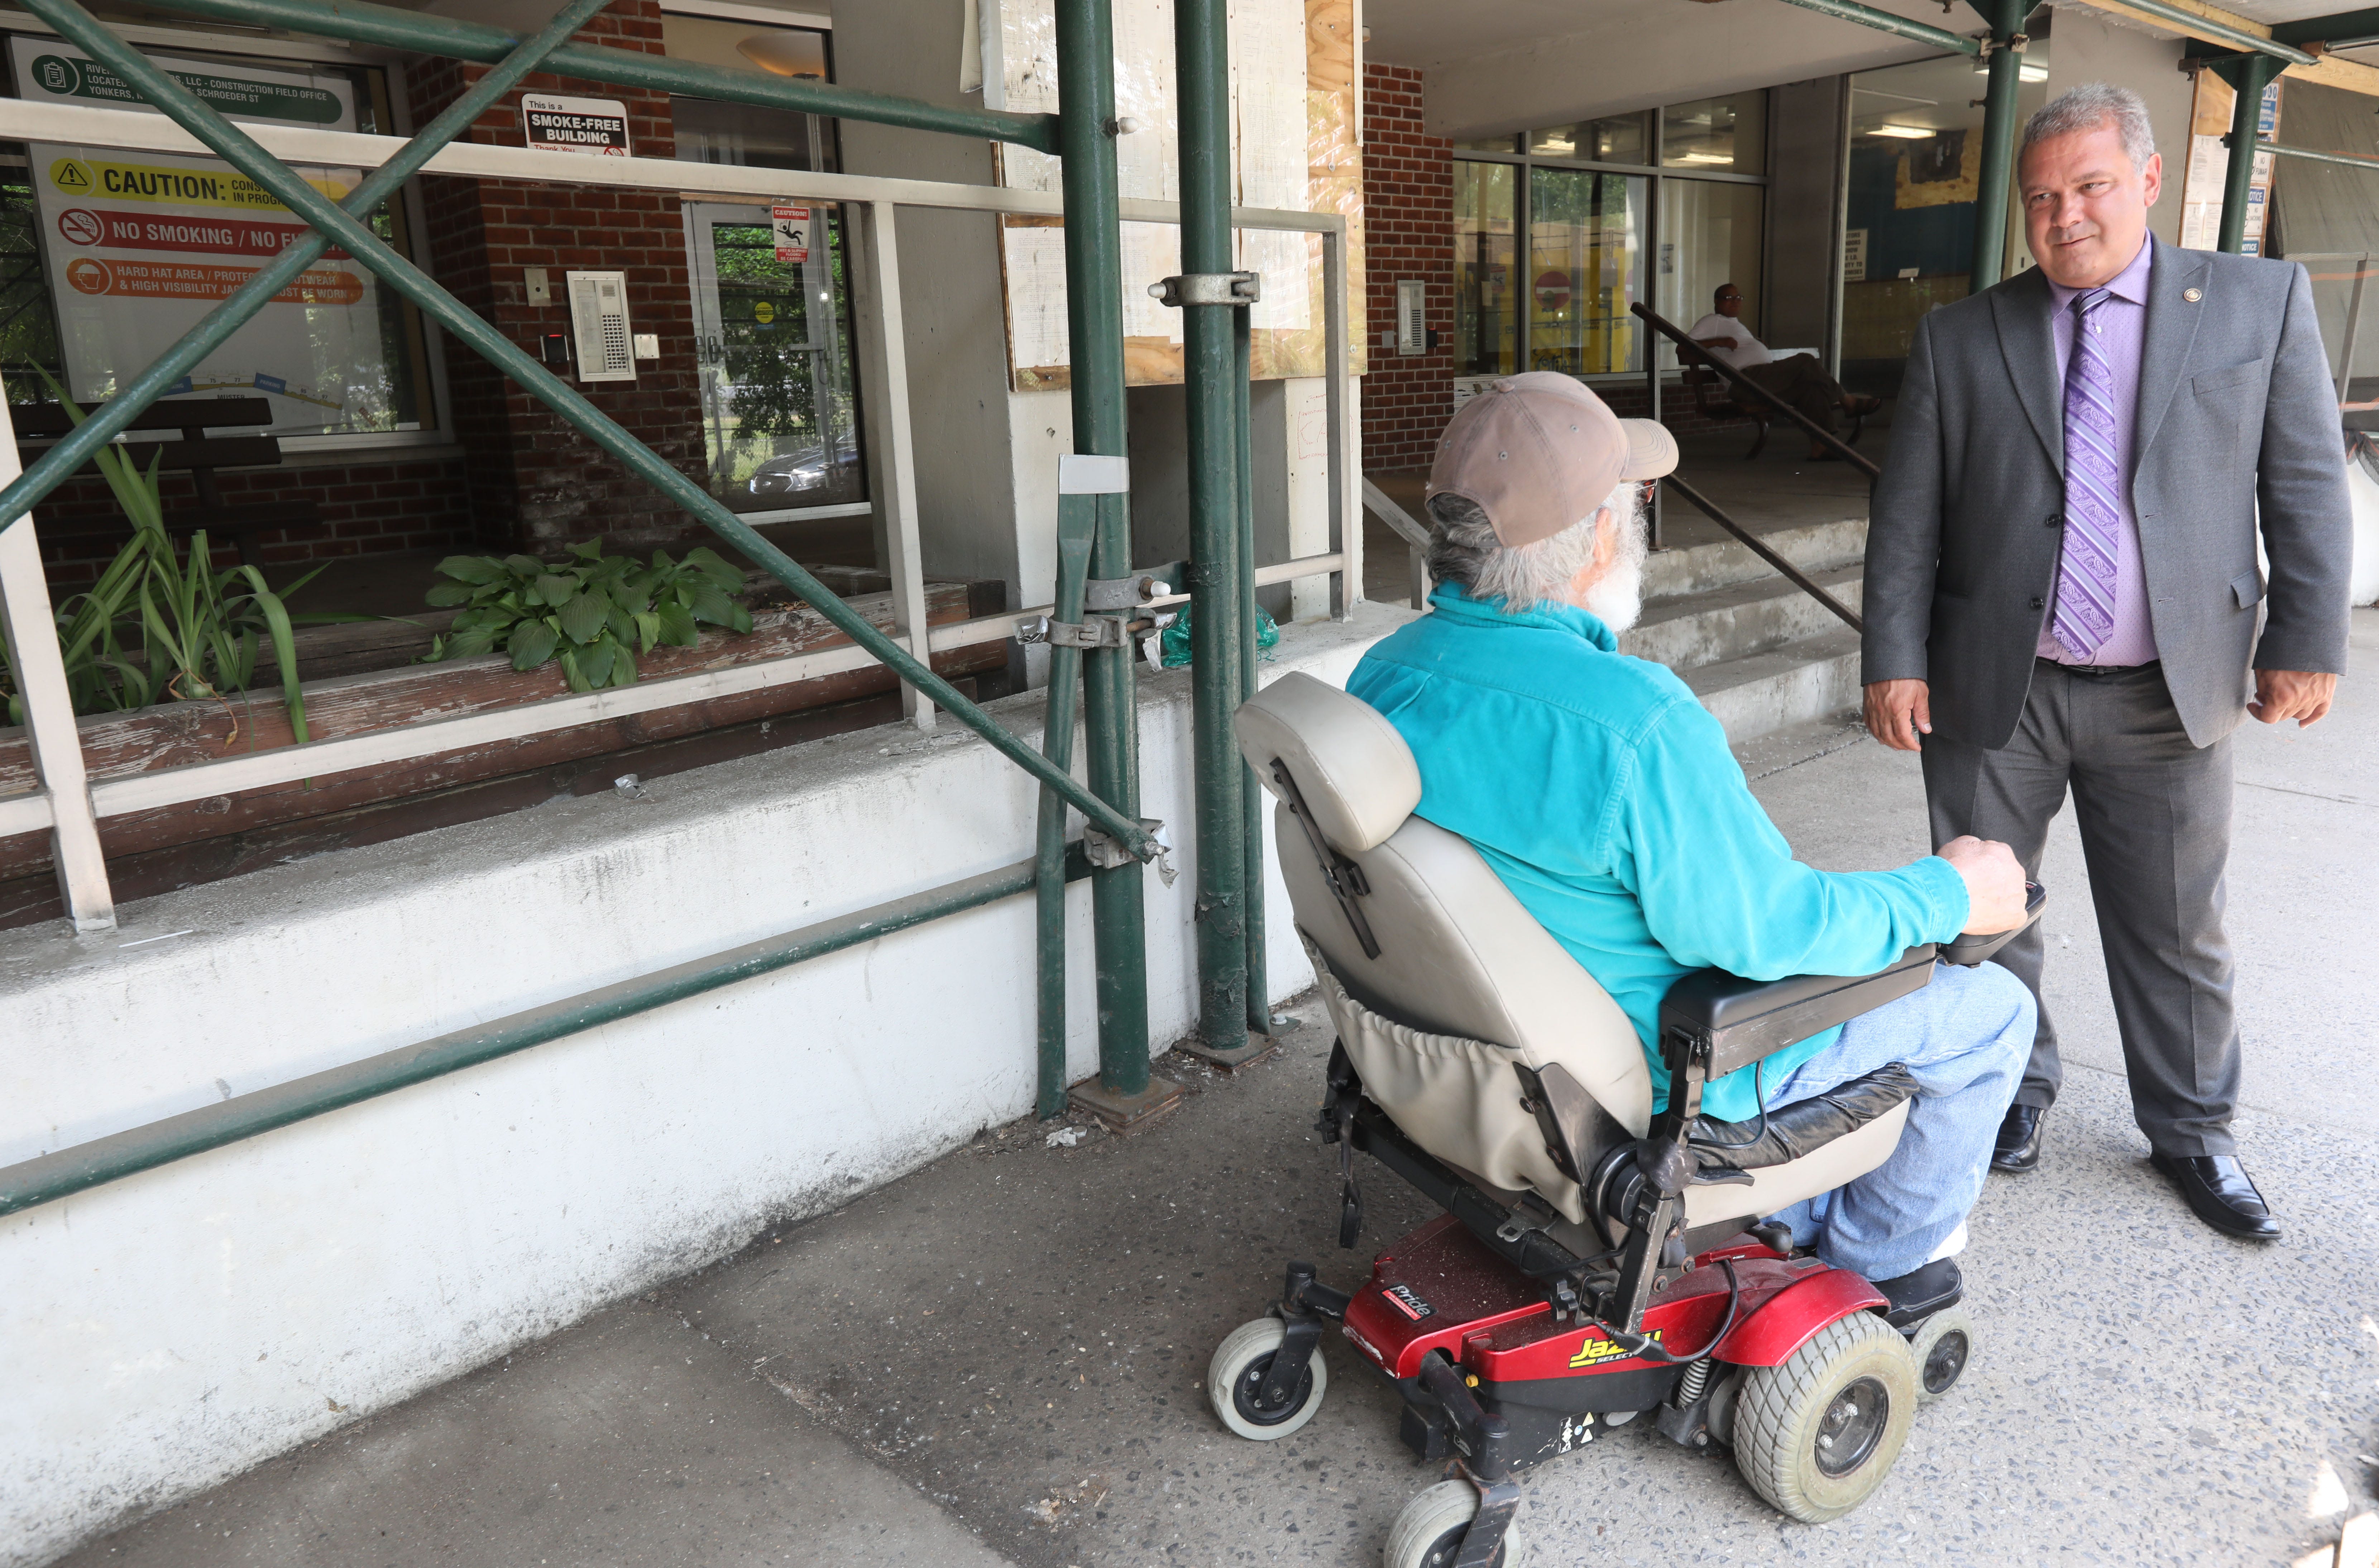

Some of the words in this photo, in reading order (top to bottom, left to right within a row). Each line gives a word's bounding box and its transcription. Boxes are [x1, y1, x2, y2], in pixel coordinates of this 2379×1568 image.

[89, 85, 134, 100] YONKERS,
[186, 77, 201, 86] LLC
[210, 80, 273, 95] CONSTRUCTION
[276, 88, 298, 97] FIELD
[300, 90, 327, 100] OFFICE
[197, 89, 246, 102] SCHROEDER
[529, 101, 546, 109] This
[531, 114, 621, 131] SMOKE-FREE
[546, 129, 610, 144] BUILDING
[104, 169, 226, 201] CAUTION:
[232, 180, 262, 191] CONS
[233, 192, 244, 202] IN
[248, 193, 284, 205] PROG
[113, 221, 140, 239] NO
[147, 224, 233, 245] SMOKING
[239, 230, 245, 247] /
[251, 231, 275, 248] NO
[117, 266, 148, 277] HARD
[152, 268, 172, 278] HAT
[176, 269, 204, 279] AREA
[207, 271, 211, 281] /
[120, 280, 128, 290] &
[132, 281, 158, 291] HIGH
[163, 282, 217, 293] VISIBILITY
[317, 289, 347, 298] WORN
[260, 379, 280, 388] PARKING
[1389, 1285, 1430, 1315] Pride
